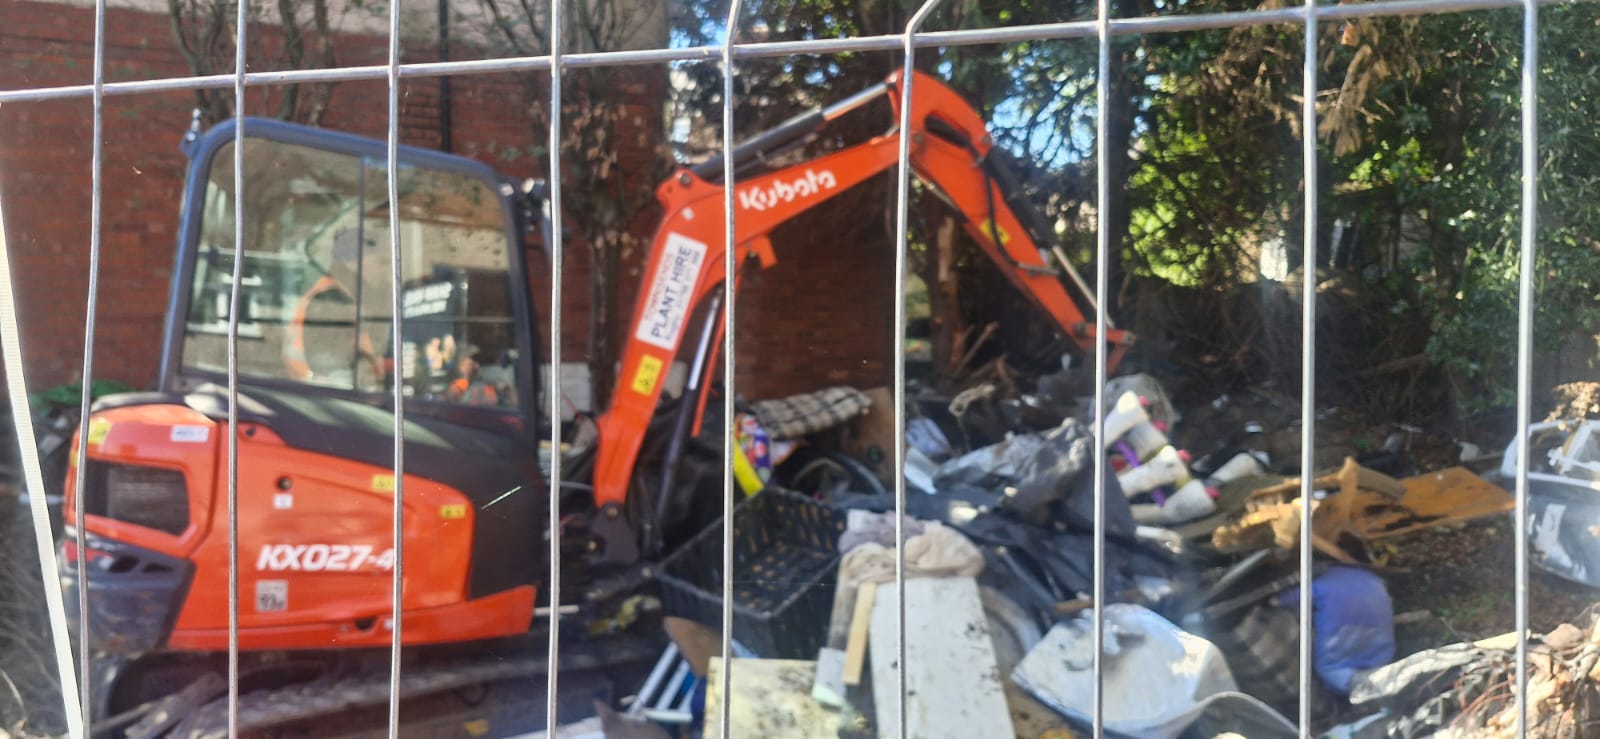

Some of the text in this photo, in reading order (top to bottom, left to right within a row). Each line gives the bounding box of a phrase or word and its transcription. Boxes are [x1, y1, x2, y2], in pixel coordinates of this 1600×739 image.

[739, 169, 836, 211] Kubota
[651, 285, 676, 338] PLANT
[670, 245, 692, 282] HIRE
[256, 543, 397, 571] KX027-4
